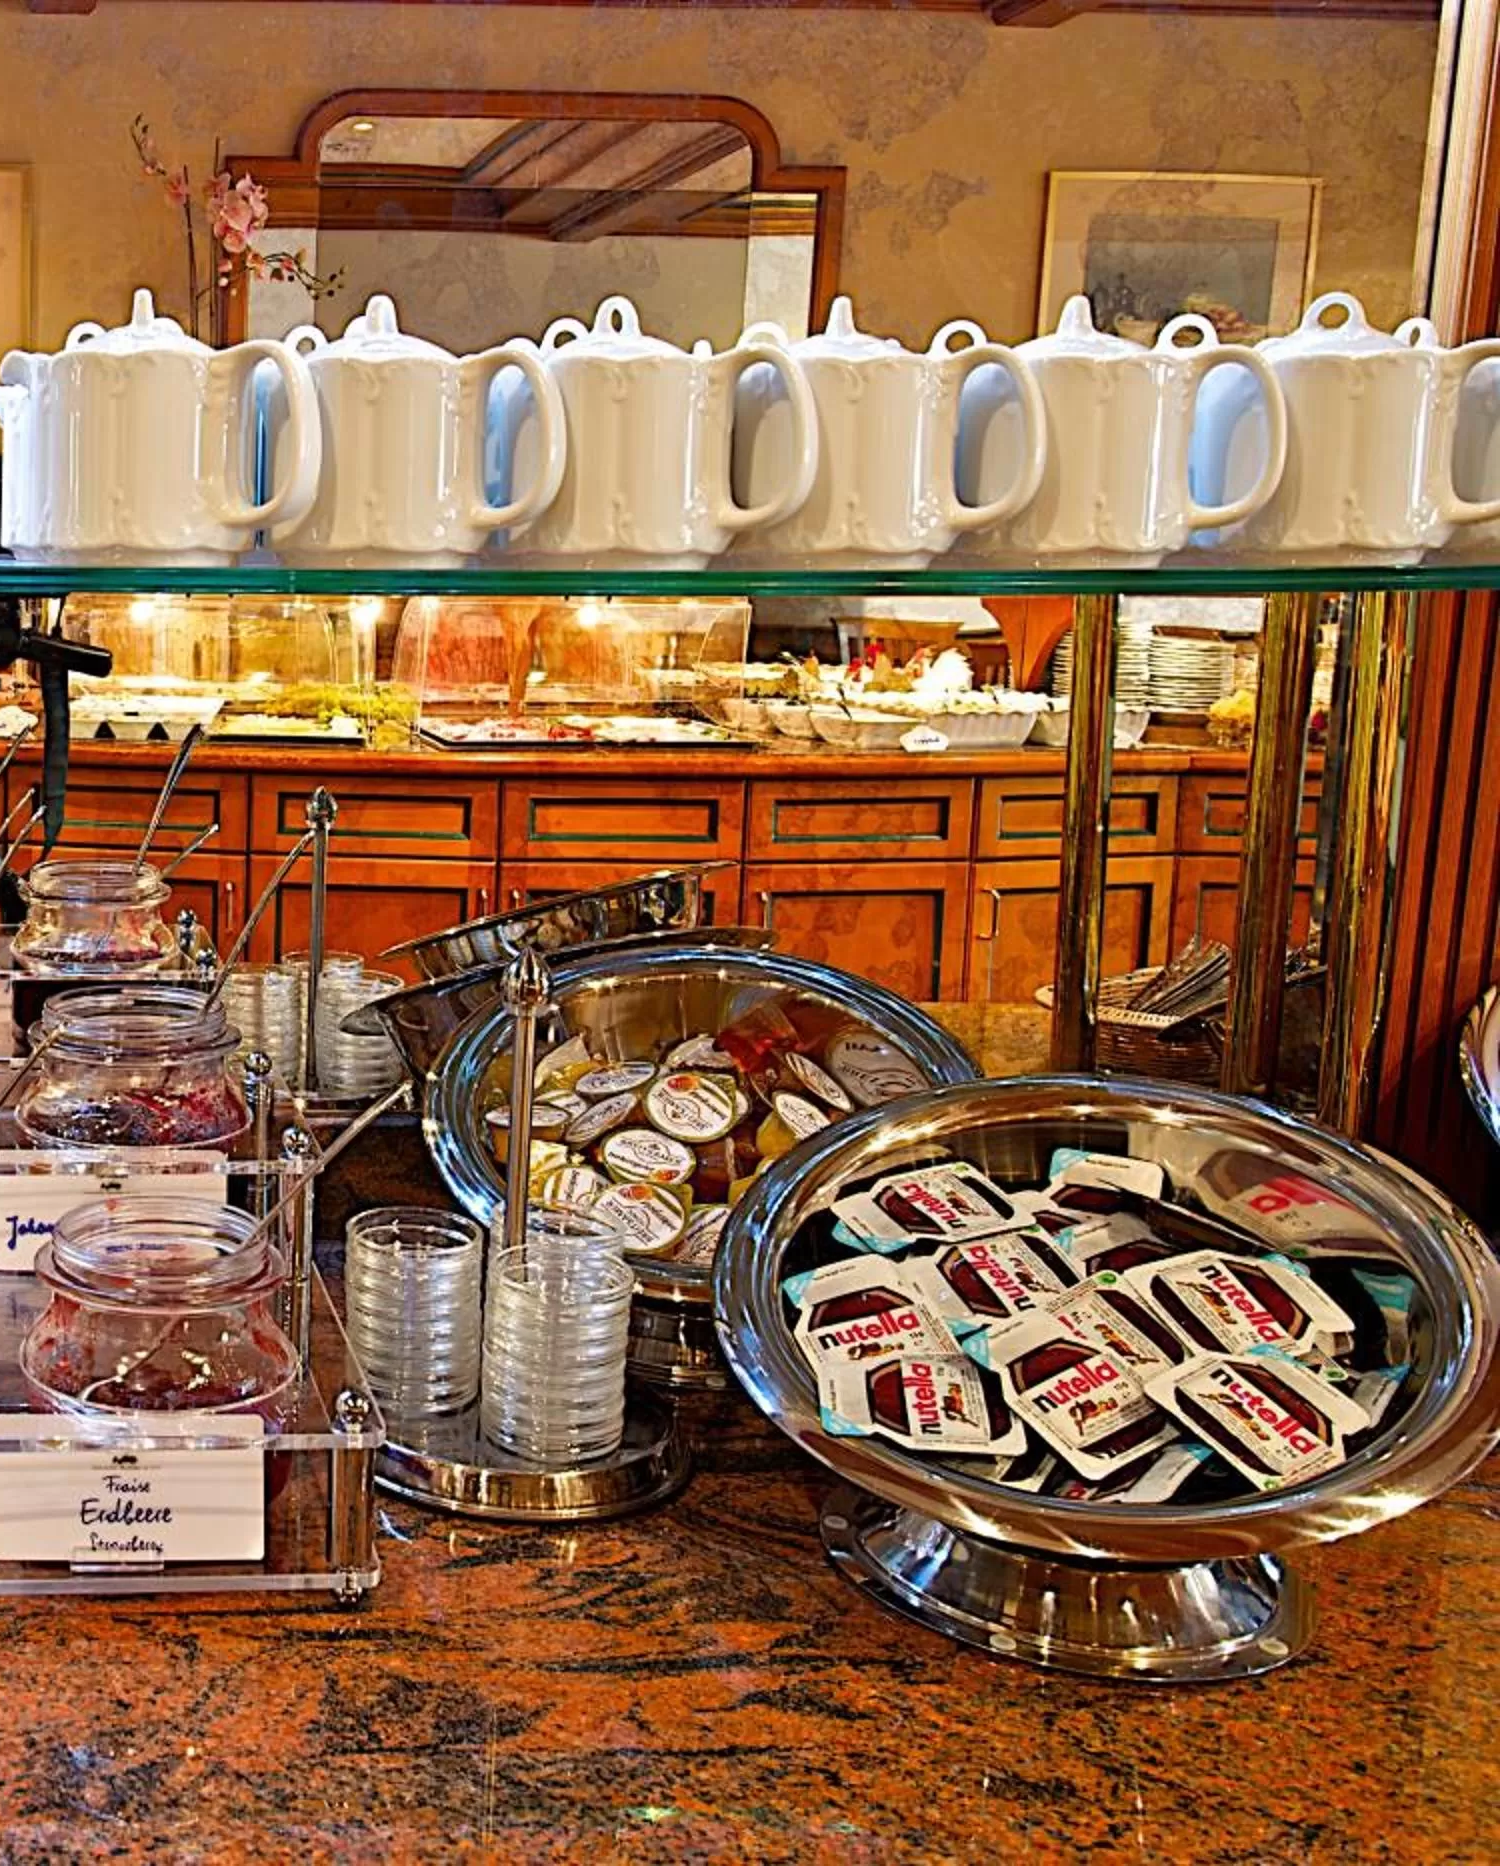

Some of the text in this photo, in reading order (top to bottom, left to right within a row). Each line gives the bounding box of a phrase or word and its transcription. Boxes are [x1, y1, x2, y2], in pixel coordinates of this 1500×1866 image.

[902, 1182, 967, 1229] nutella
[968, 1244, 1037, 1311] nutella
[1199, 1264, 1285, 1343] nutella
[818, 1312, 920, 1351] nutella
[903, 1362, 943, 1436] nutella
[1032, 1360, 1120, 1414] nutella
[1210, 1368, 1320, 1455] nutella
[103, 1475, 150, 1493] Fraise
[81, 1498, 173, 1526] Erdbeere
